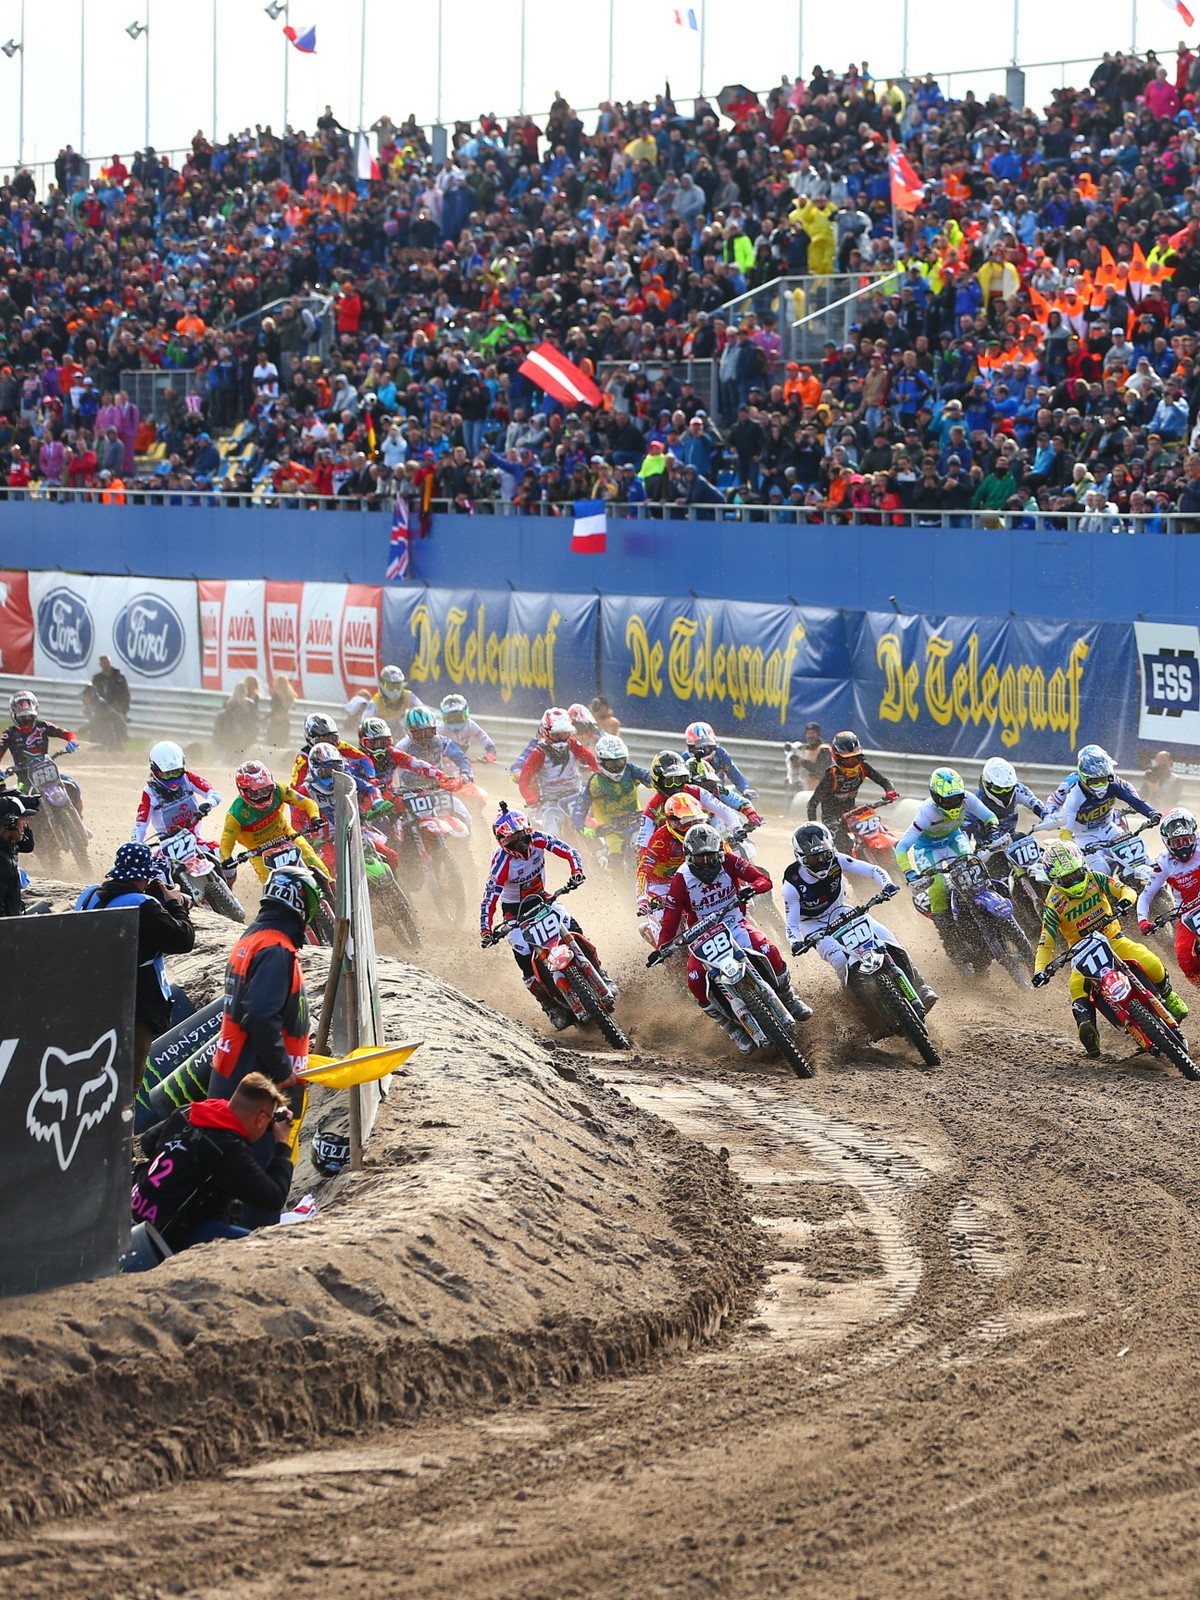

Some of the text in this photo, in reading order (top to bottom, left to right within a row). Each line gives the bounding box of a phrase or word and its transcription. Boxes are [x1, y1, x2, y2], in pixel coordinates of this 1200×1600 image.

[48, 599, 82, 654] Ford
[127, 605, 169, 663] Ford
[410, 603, 561, 701] De Telegraaf
[625, 614, 807, 726] De Telegraaf
[1151, 662, 1193, 702] ESS
[876, 632, 1090, 751] De Telegraaf
[855, 816, 880, 835] 26
[167, 834, 196, 861] 122
[273, 849, 298, 868] 104
[1014, 843, 1039, 865] 116
[1119, 842, 1143, 863] 32
[1064, 892, 1102, 922] THOR
[529, 913, 559, 946] 119
[841, 920, 873, 949] 50
[701, 931, 731, 962] 98
[1082, 945, 1109, 975] 11
